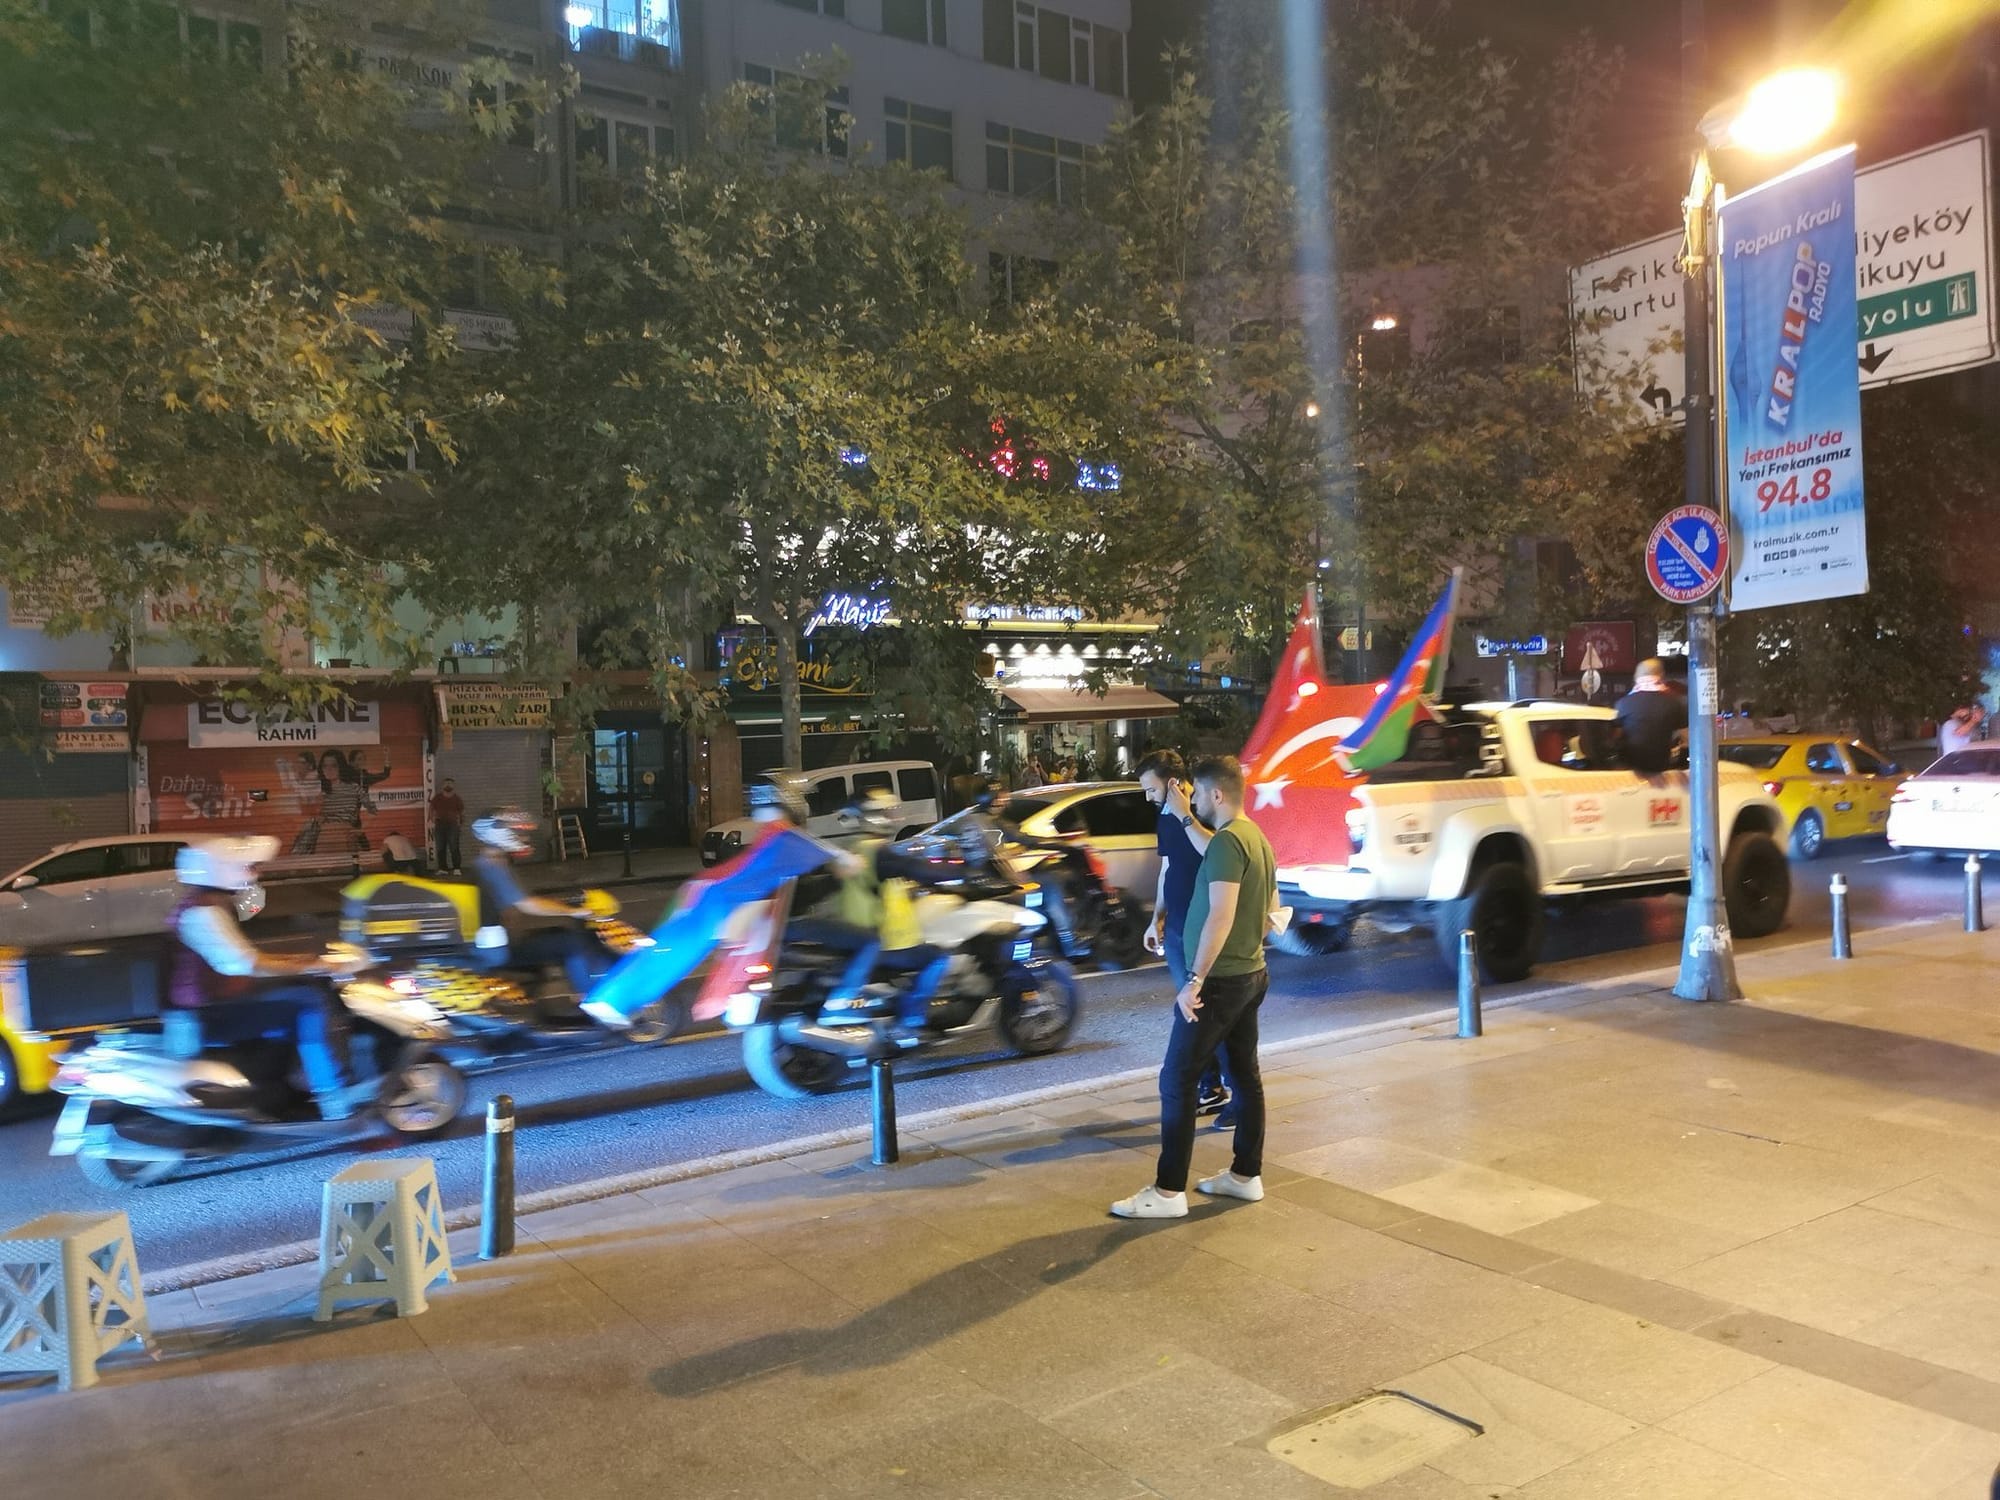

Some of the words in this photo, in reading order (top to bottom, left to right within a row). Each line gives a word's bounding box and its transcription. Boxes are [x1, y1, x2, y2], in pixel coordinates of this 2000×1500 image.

[1734, 224, 1792, 260] Popun
[1795, 200, 1842, 234] Kralı
[1859, 250, 1946, 289] ikuyu
[1808, 261, 1831, 323] RADYO
[1857, 299, 1932, 335] yolu
[1738, 468, 1766, 483] Yeni
[1768, 448, 1852, 477] Frekansımız
[1743, 431, 1843, 467] İstanbul'da
[1757, 468, 1832, 513] 94.8
[1753, 526, 1840, 550] kralmuzik.com.tr
[1660, 582, 1680, 599] PARK
[451, 704, 497, 715] BURSA
[257, 724, 318, 741] RAHMİ
[160, 774, 206, 793] Daha
